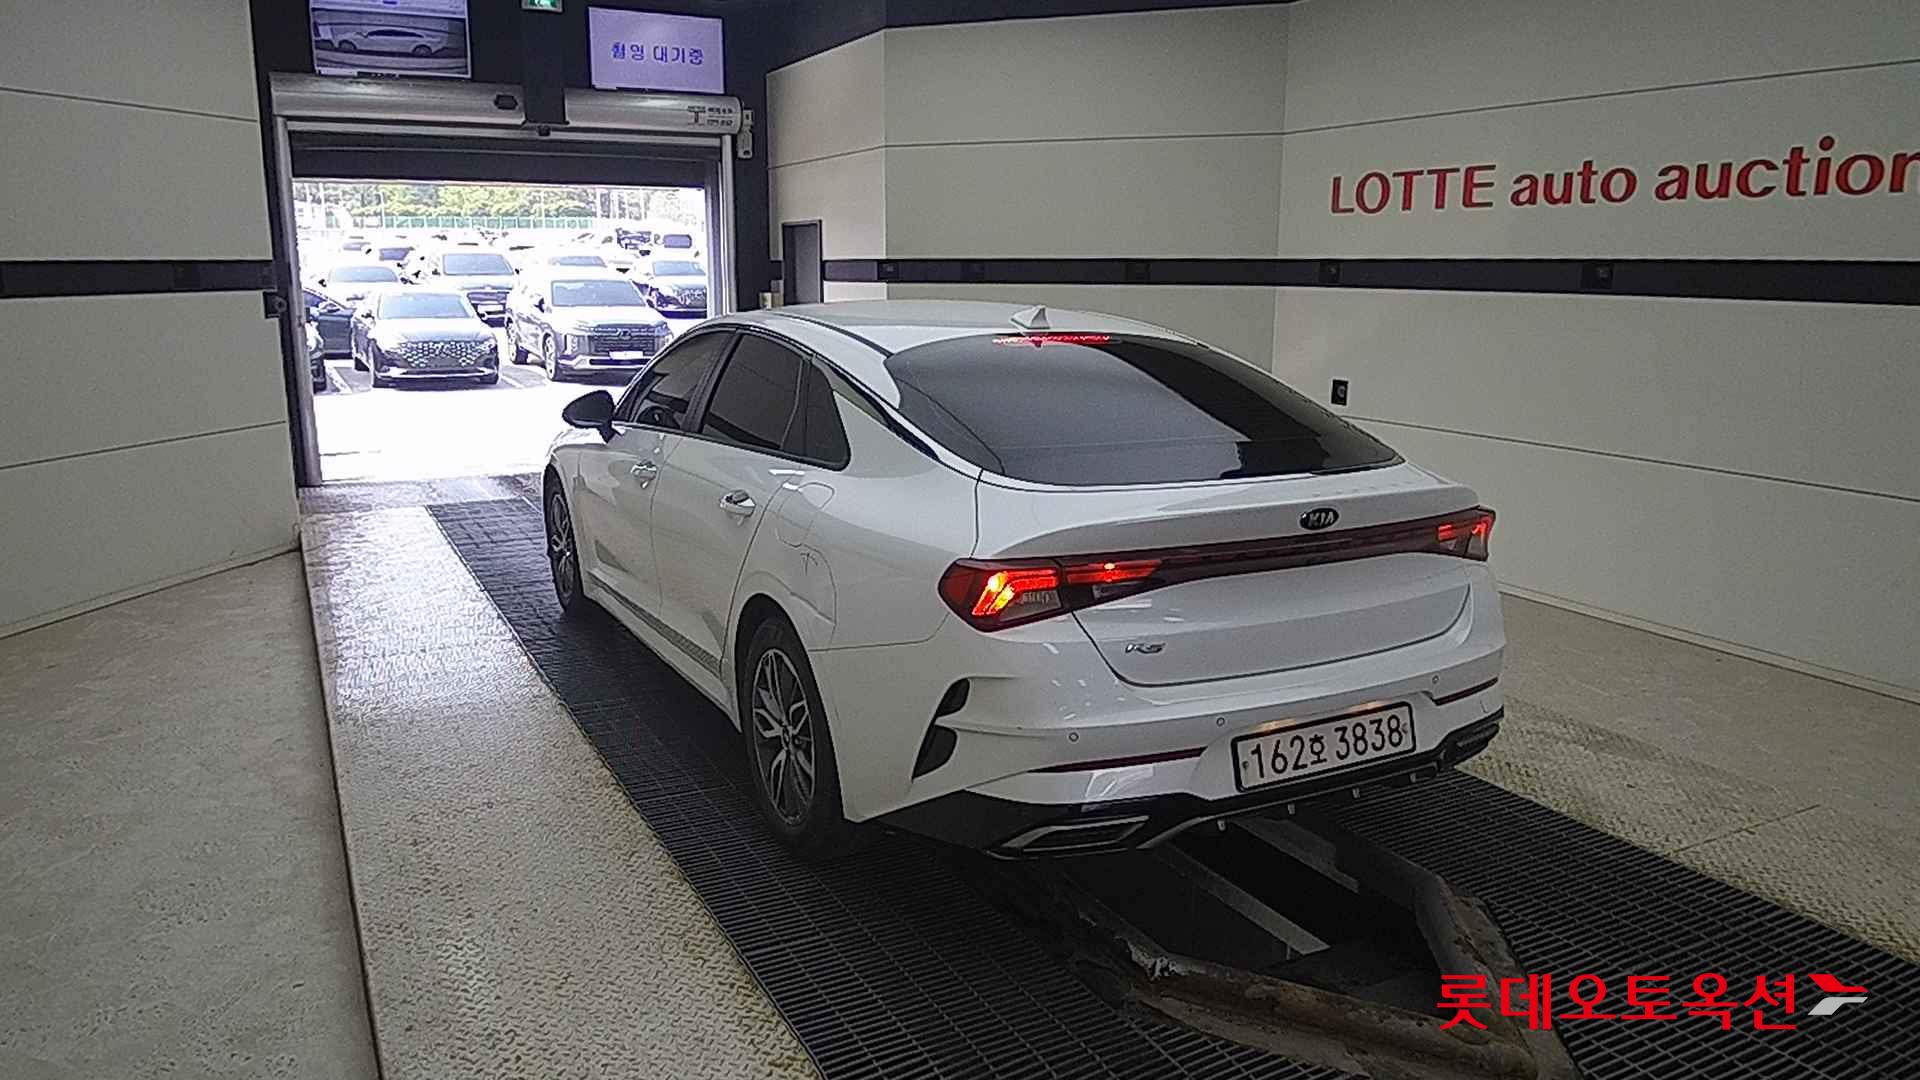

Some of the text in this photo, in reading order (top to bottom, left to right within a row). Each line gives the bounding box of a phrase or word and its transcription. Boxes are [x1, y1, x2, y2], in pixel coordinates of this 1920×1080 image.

[653, 45, 703, 65] 대기중
[1330, 163, 1496, 214] LOTTE
[1510, 160, 1638, 206] auto
[1309, 511, 1334, 527] KIA
[1251, 714, 1402, 778] 162호 3838
